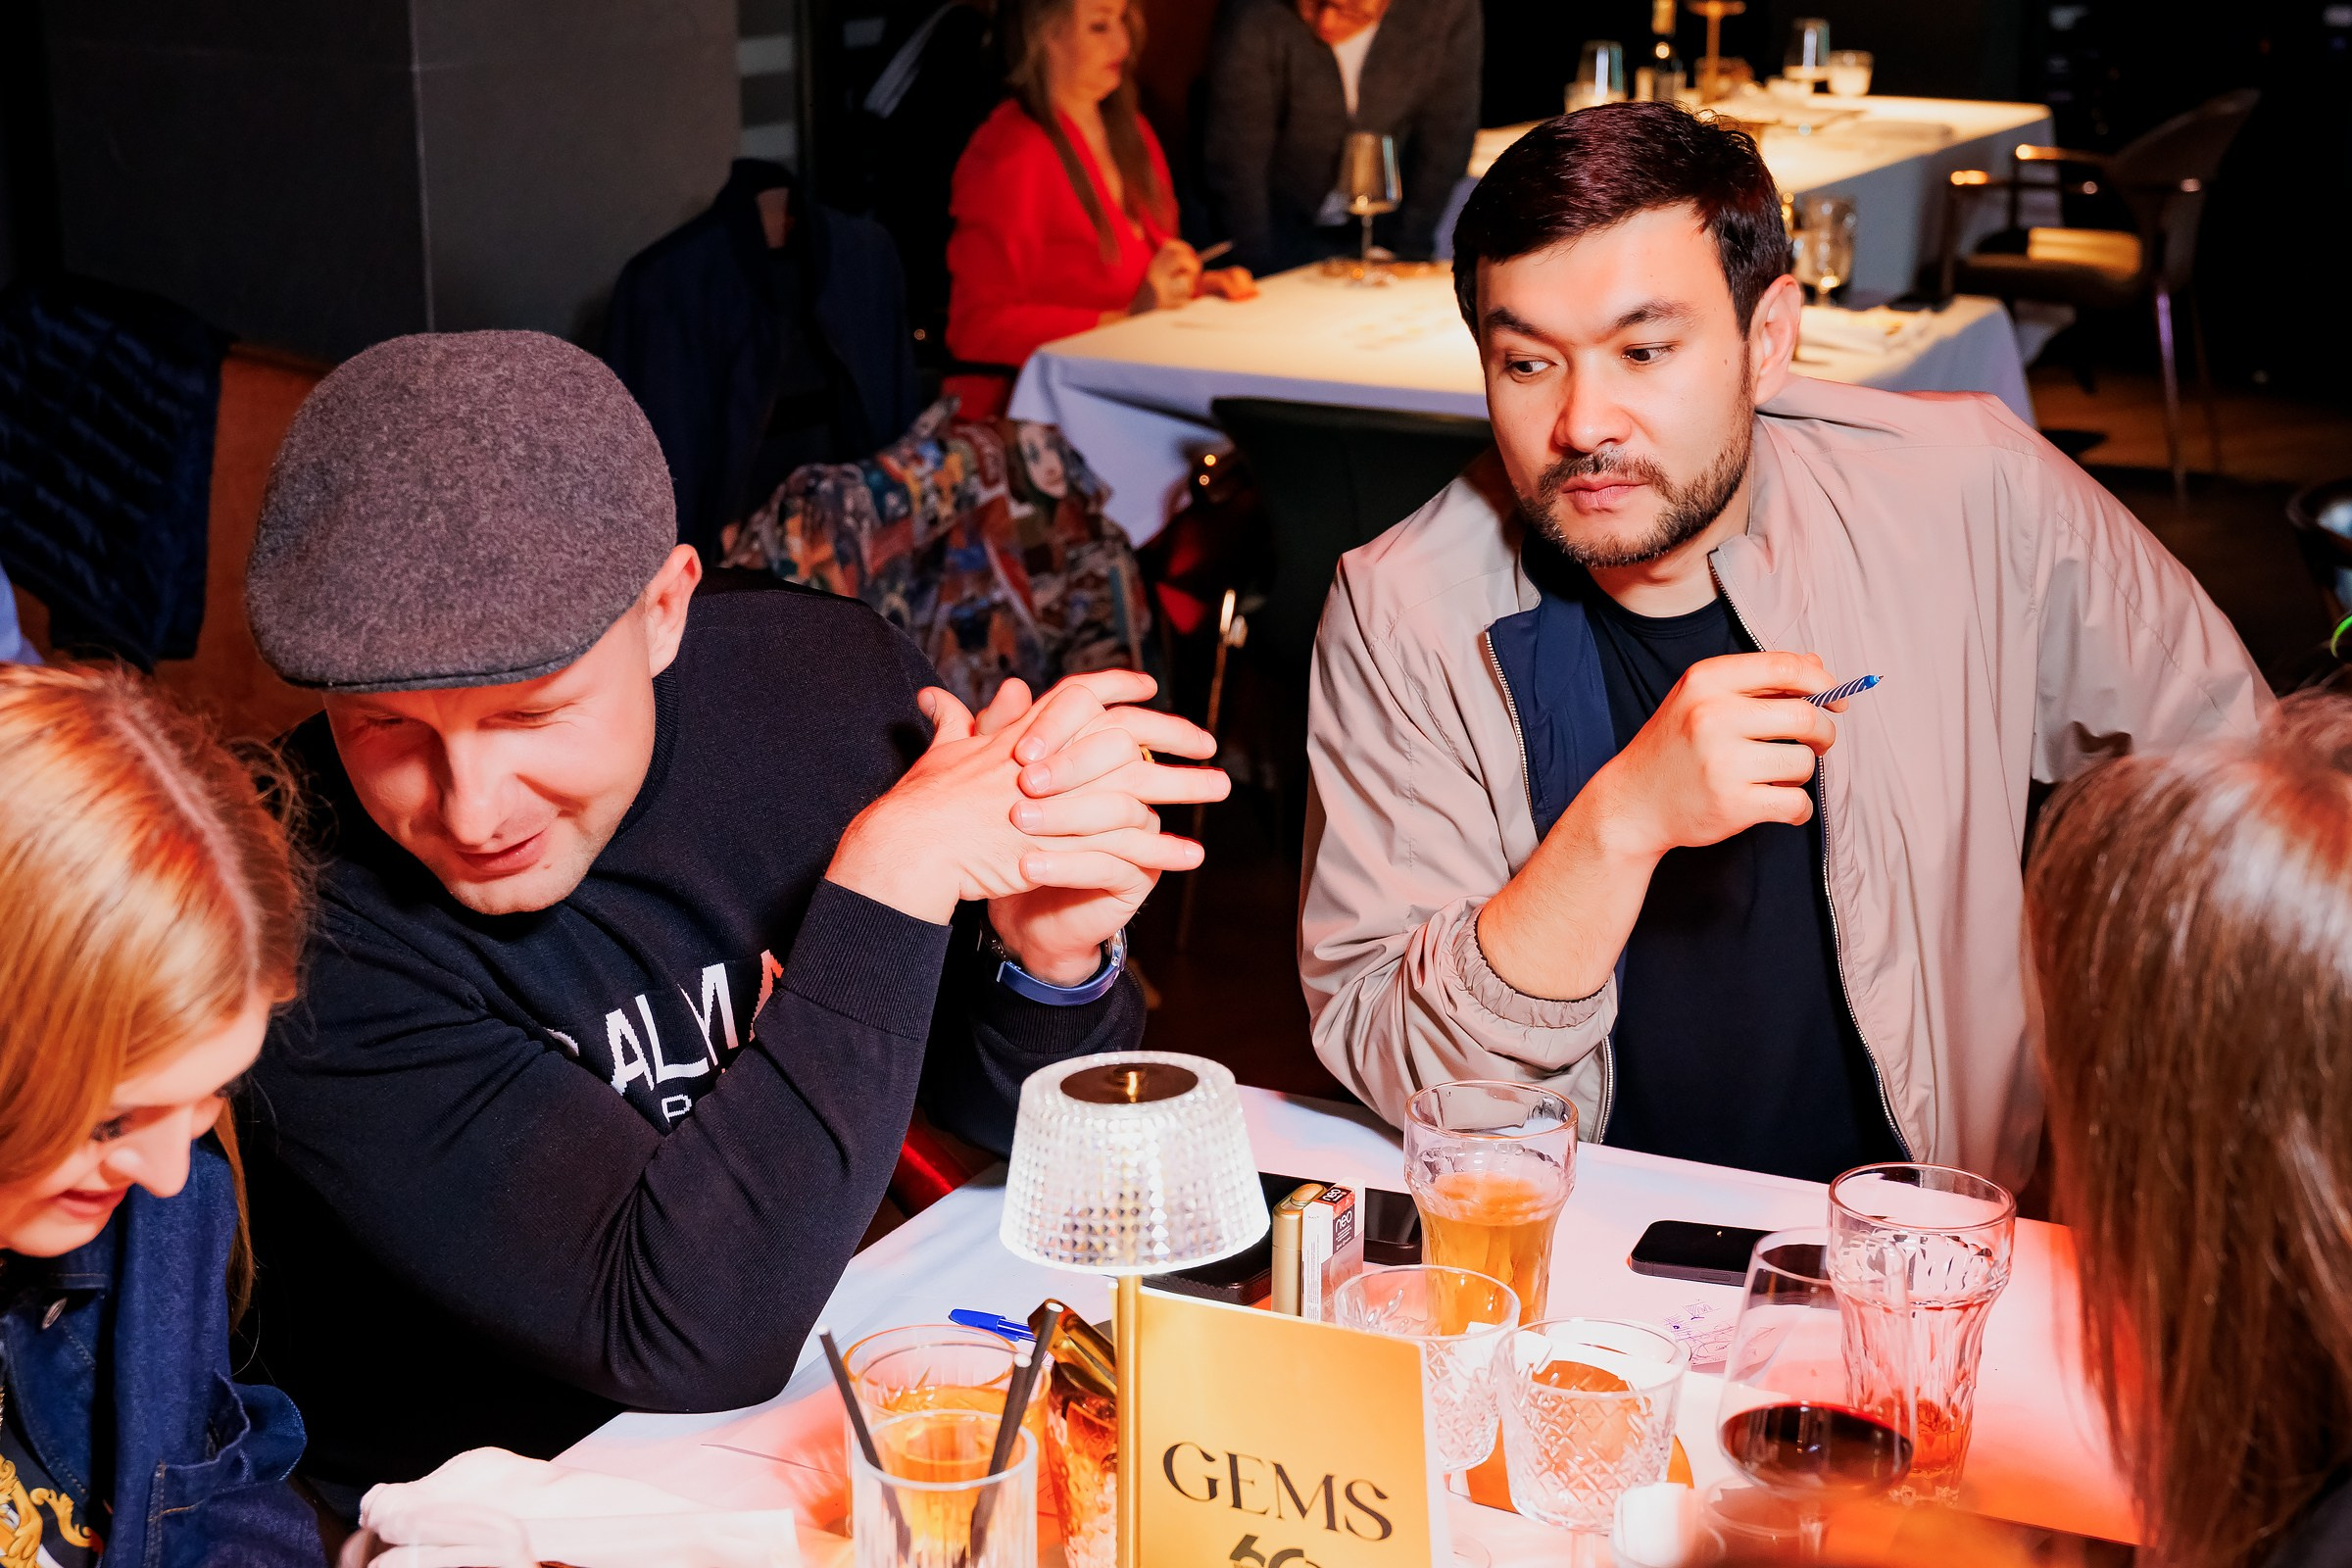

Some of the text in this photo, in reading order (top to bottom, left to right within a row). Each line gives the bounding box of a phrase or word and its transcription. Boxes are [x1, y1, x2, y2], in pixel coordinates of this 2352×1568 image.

[1322, 1188, 1342, 1201] neo
[1335, 1209, 1352, 1233] neo
[1162, 1441, 1393, 1542] GEMS
